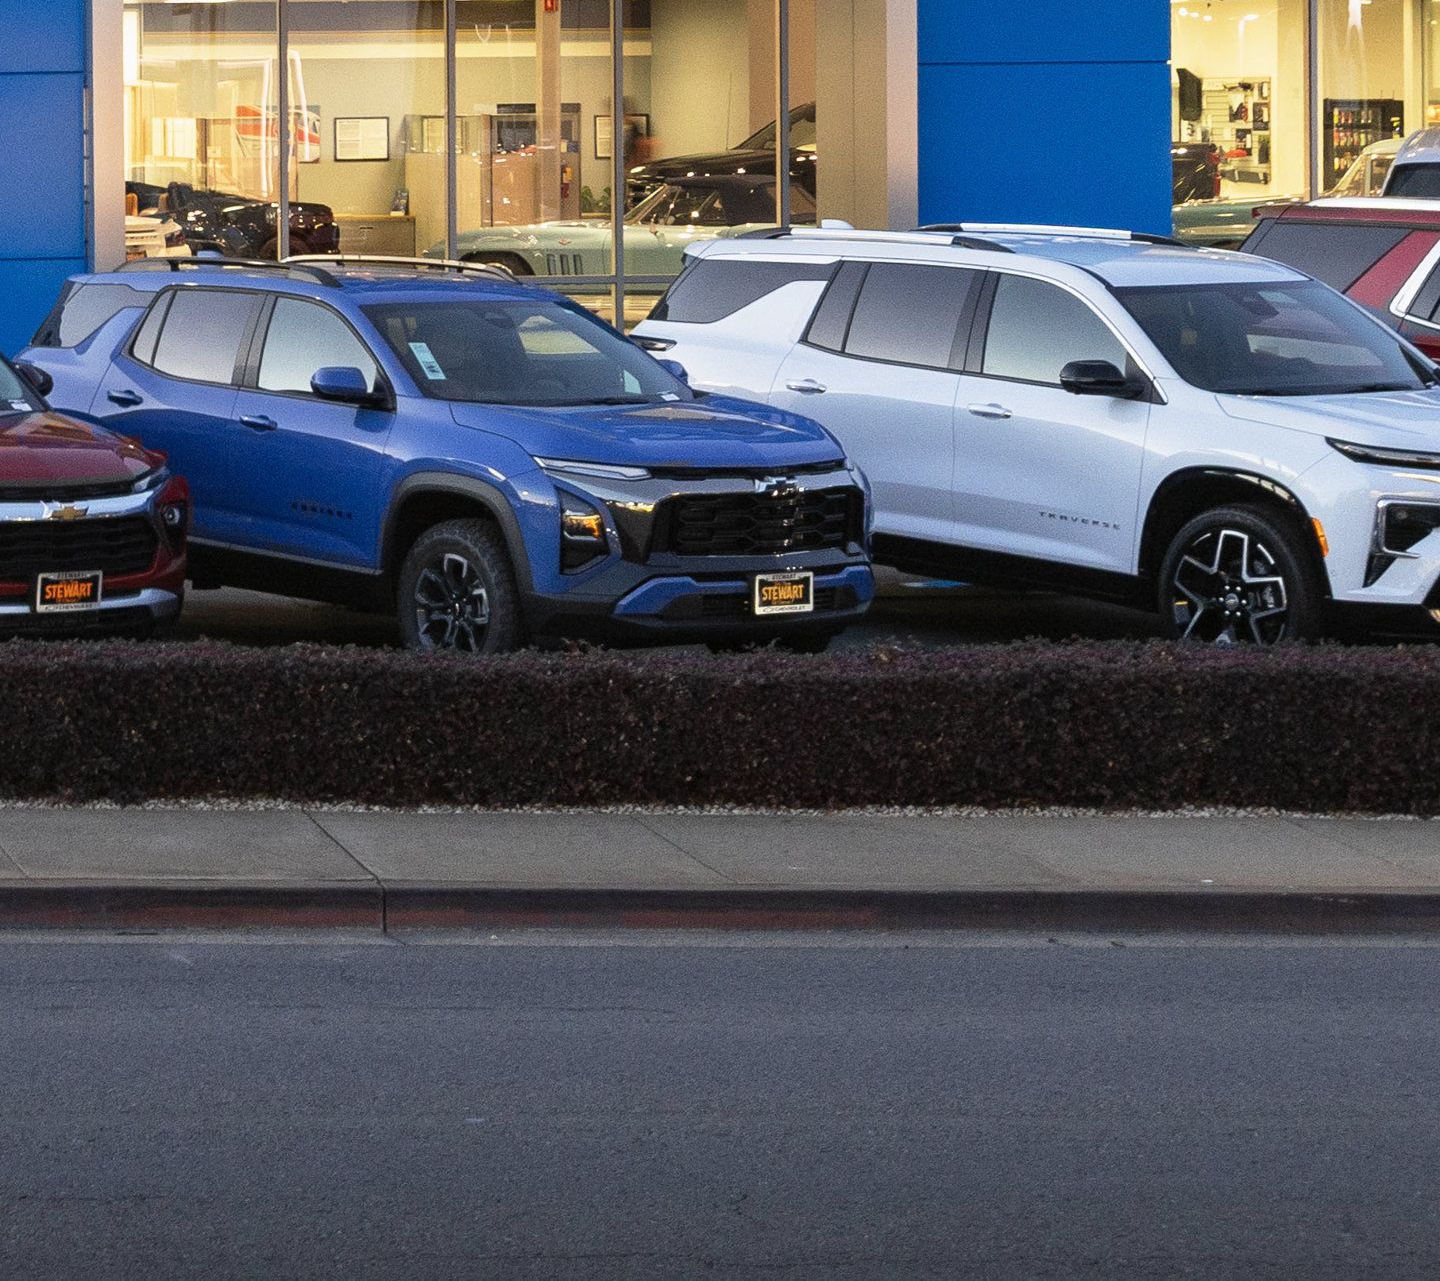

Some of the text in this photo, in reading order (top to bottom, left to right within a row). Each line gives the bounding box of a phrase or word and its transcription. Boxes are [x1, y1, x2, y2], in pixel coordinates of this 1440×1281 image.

[1039, 511, 1120, 531] TRAVERSE
[44, 582, 93, 600] STEWART
[762, 584, 804, 601] STEWART
